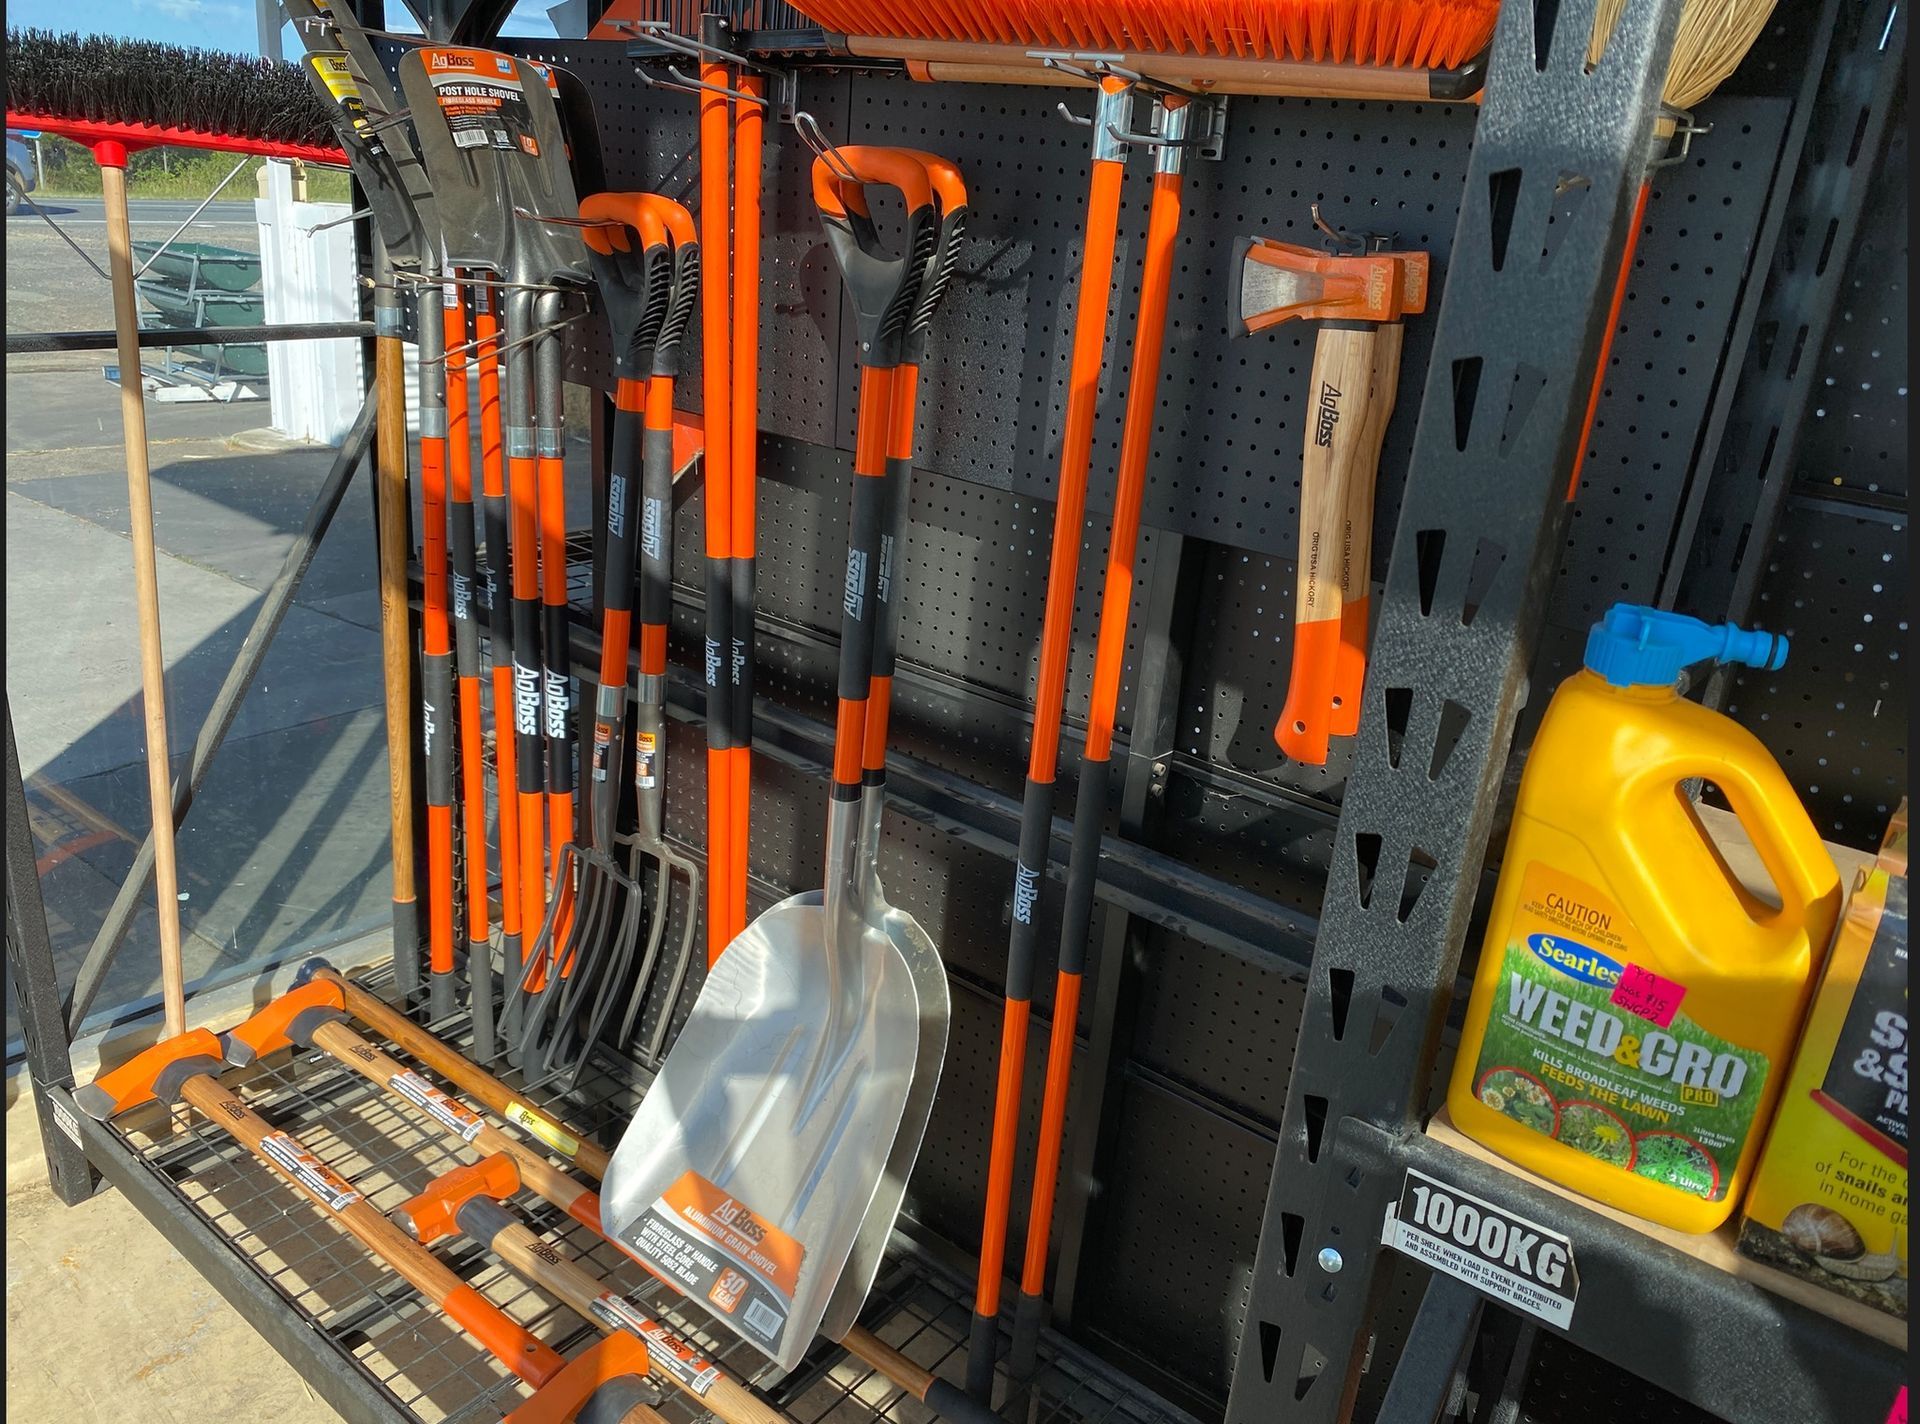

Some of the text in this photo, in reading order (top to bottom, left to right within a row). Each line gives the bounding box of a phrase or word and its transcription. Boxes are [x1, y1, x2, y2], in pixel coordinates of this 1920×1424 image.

[432, 53, 475, 69] AgBoss
[439, 86, 520, 101] POST HOLE SHOVEL
[1315, 381, 1342, 448] AgBoss
[1311, 531, 1319, 552] ORIG
[453, 571, 471, 620] AgBoss
[844, 547, 867, 621] AgBoss
[1308, 571, 1316, 607] HICKORY
[515, 660, 540, 735] AgBoss
[543, 664, 569, 739] AgBoss
[1014, 859, 1040, 925] AgBoss
[1546, 893, 1611, 930] CAUTION
[1545, 905, 1556, 915] OUT
[1565, 912, 1585, 926] REACH
[1593, 925, 1622, 943] CHILDREN
[1538, 937, 1620, 985] Searles
[1532, 1048, 1564, 1069] KILLS
[1565, 1063, 1638, 1100] BROADLEAF
[1640, 1092, 1686, 1116] WEEDS
[1540, 1063, 1585, 1092] FEEDS
[1588, 1084, 1618, 1106] THE
[1621, 1098, 1670, 1124] LAWN
[1683, 1087, 1714, 1104] PRO
[1669, 1173, 1677, 1183] 2
[1815, 1161, 1832, 1175] of
[1835, 1170, 1887, 1198] snails
[1840, 1151, 1868, 1171] For
[1871, 1164, 1897, 1184] the
[1819, 1179, 1834, 1195] in
[1840, 1187, 1886, 1216] home
[682, 1205, 777, 1276] ALUMINIUM GRAIN SHOVEL
[710, 1199, 768, 1246] AgBoss
[1412, 1186, 1567, 1288] 1000KG
[525, 1242, 561, 1266] AgBoss
[635, 1236, 699, 1286] QUALITY 5052 BLADE
[640, 1226, 695, 1269] WITH STEEL CORE
[646, 1218, 685, 1248] FIBREGLASS
[691, 1250, 719, 1273] HANDLE
[720, 1271, 746, 1295] 30
[1404, 1240, 1542, 1311] AND ASSEMBLED WITH SUPPORT BRACES.
[1406, 1231, 1420, 1243] PER
[1443, 1248, 1463, 1263] WHEN
[1463, 1258, 1480, 1272] LOAD
[1482, 1266, 1490, 1276] IS
[1491, 1271, 1516, 1288] EVENLY
[1517, 1284, 1562, 1310] DISTRIBUTED
[714, 1287, 735, 1306] YEAR
[647, 1328, 686, 1355] AgBoss
